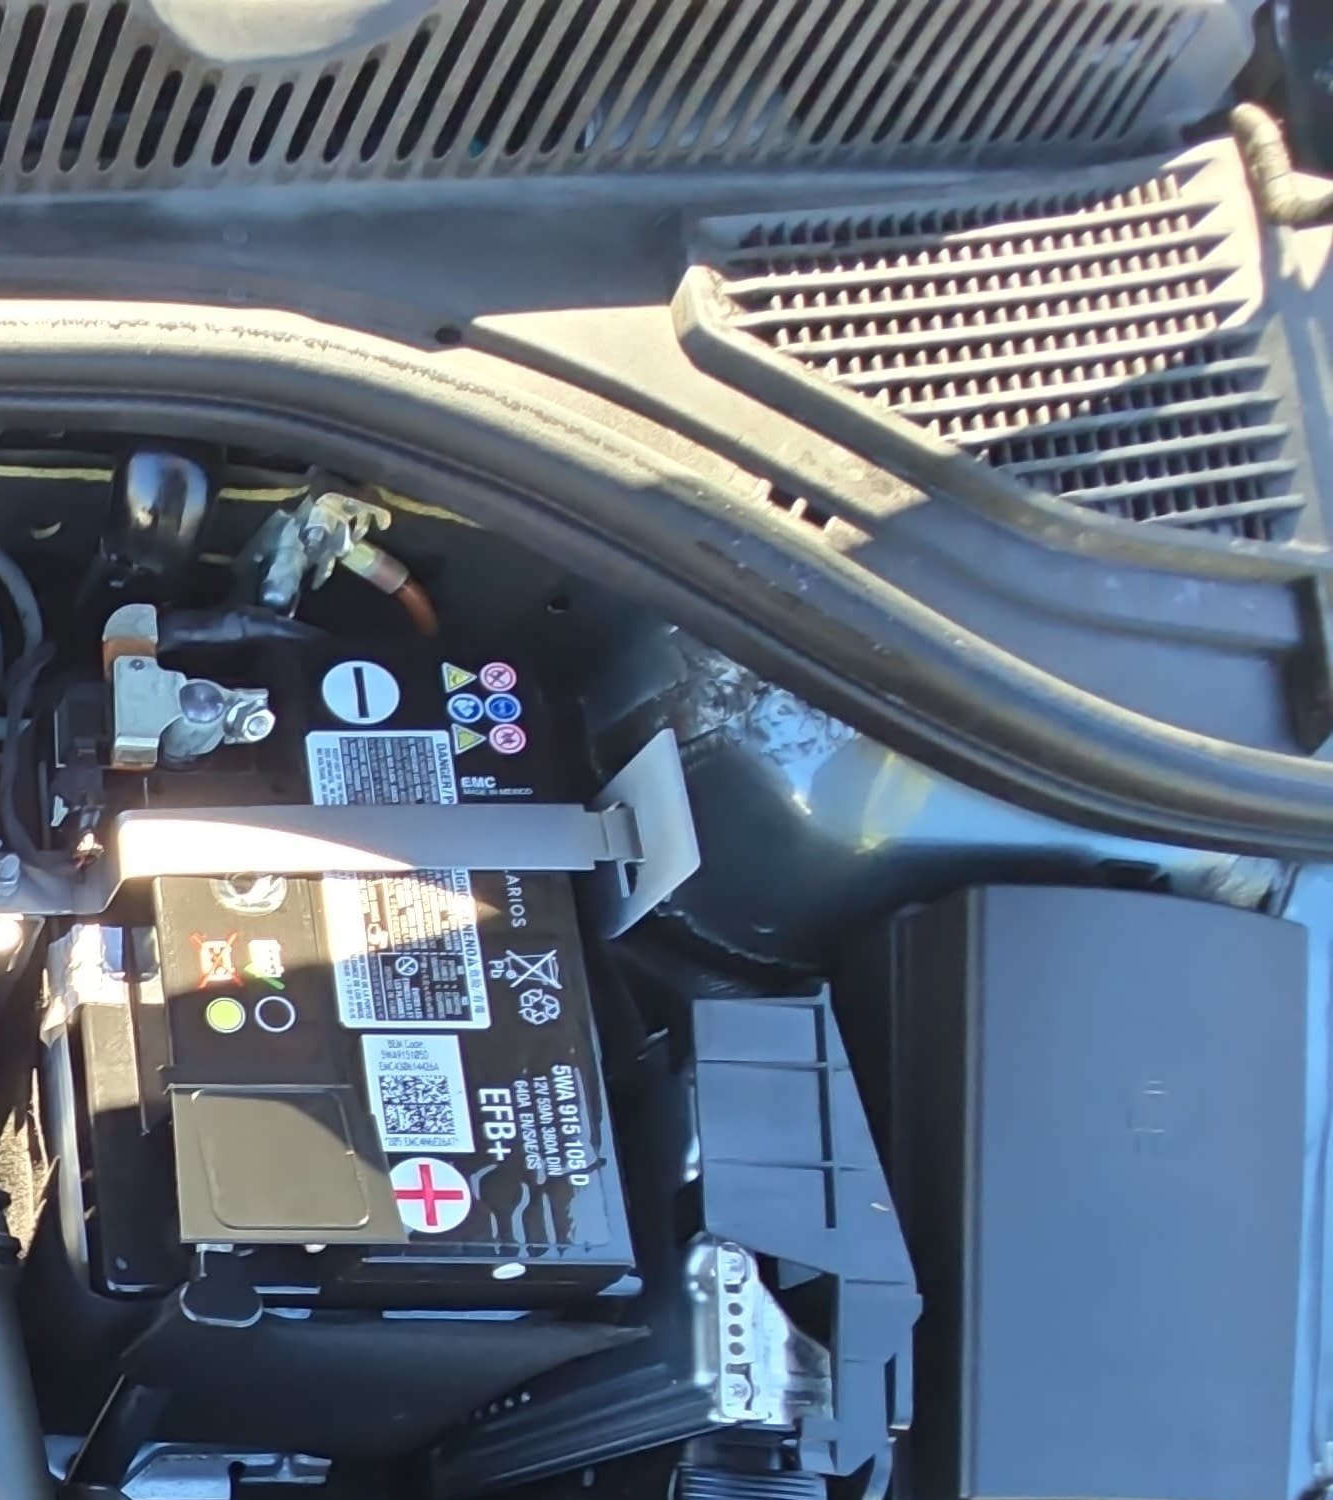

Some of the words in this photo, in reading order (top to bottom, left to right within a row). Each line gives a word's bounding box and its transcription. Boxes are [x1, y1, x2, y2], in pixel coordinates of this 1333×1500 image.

[461, 776, 497, 788] EMC
[504, 870, 527, 928] ARIOS
[489, 960, 505, 979] Pb
[513, 1080, 532, 1108] 640A
[551, 1064, 577, 1101] 5WA
[478, 1088, 516, 1161] EFB+
[532, 1076, 550, 1095] 12V
[545, 1157, 563, 1176] DIN
[558, 1105, 581, 1135] 915
[563, 1141, 587, 1170] 105
[570, 1174, 590, 1186] D
